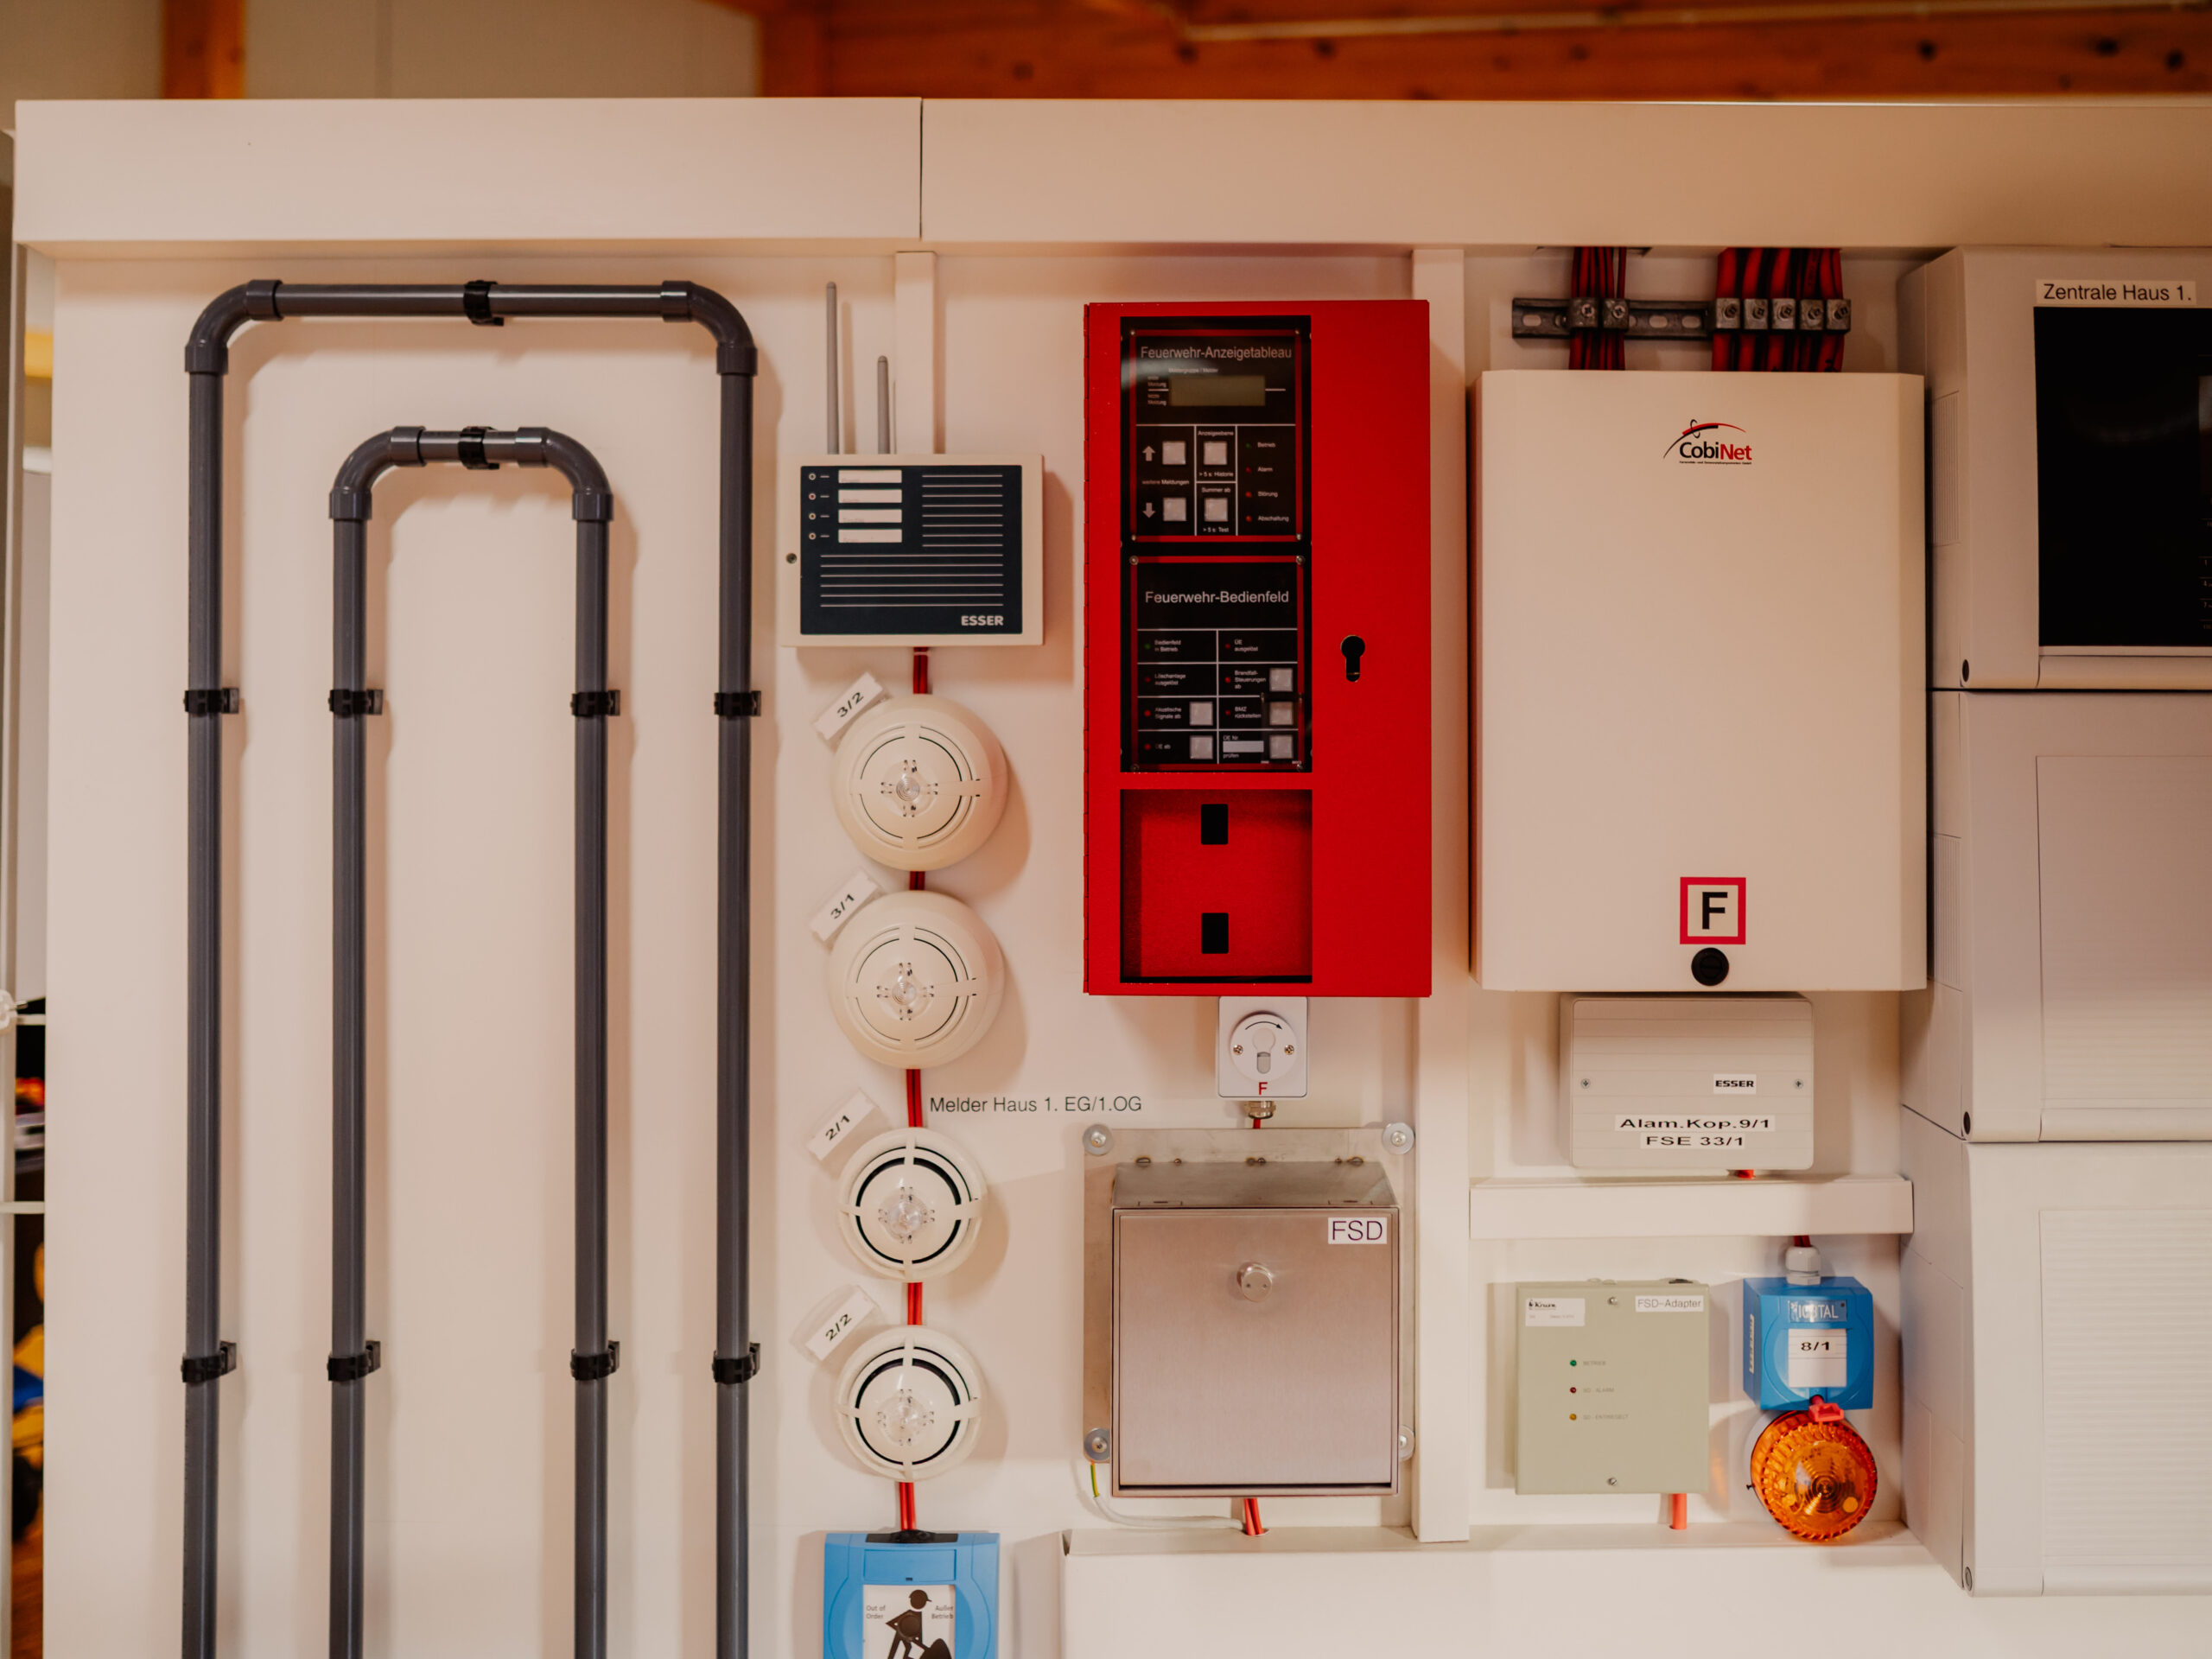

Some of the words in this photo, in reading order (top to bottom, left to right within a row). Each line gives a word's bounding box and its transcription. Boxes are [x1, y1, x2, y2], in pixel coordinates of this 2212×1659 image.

[2044, 283, 2116, 300] Zentrale
[2123, 284, 2170, 301] Haus
[2177, 285, 2192, 301] 1.
[1141, 346, 1293, 361] Feuerwehr-Anzeigetableau
[1679, 441, 1752, 461] CobiNet
[1145, 591, 1290, 604] Feuerwehr-Bedienfeld
[961, 615, 1004, 626] ESSER
[836, 691, 864, 719] 3/2
[830, 893, 855, 919] 3/1
[1702, 891, 1728, 930] F
[1258, 1082, 1268, 1095] F
[930, 1096, 988, 1112] Melder
[994, 1097, 1037, 1112] Haus
[1045, 1096, 1058, 1111] 1.
[1065, 1096, 1142, 1111] EG/1.OG
[825, 1115, 851, 1141] 2/1
[1620, 1118, 1770, 1129] Alam.Kop.9/1
[1646, 1135, 1691, 1146] FSE
[1700, 1135, 1745, 1147] 33/1
[1332, 1220, 1383, 1241] FSD
[1637, 1299, 1701, 1309] FSD-Adapter
[825, 1313, 853, 1341] 2/2
[1801, 1341, 1830, 1351] 8/1
